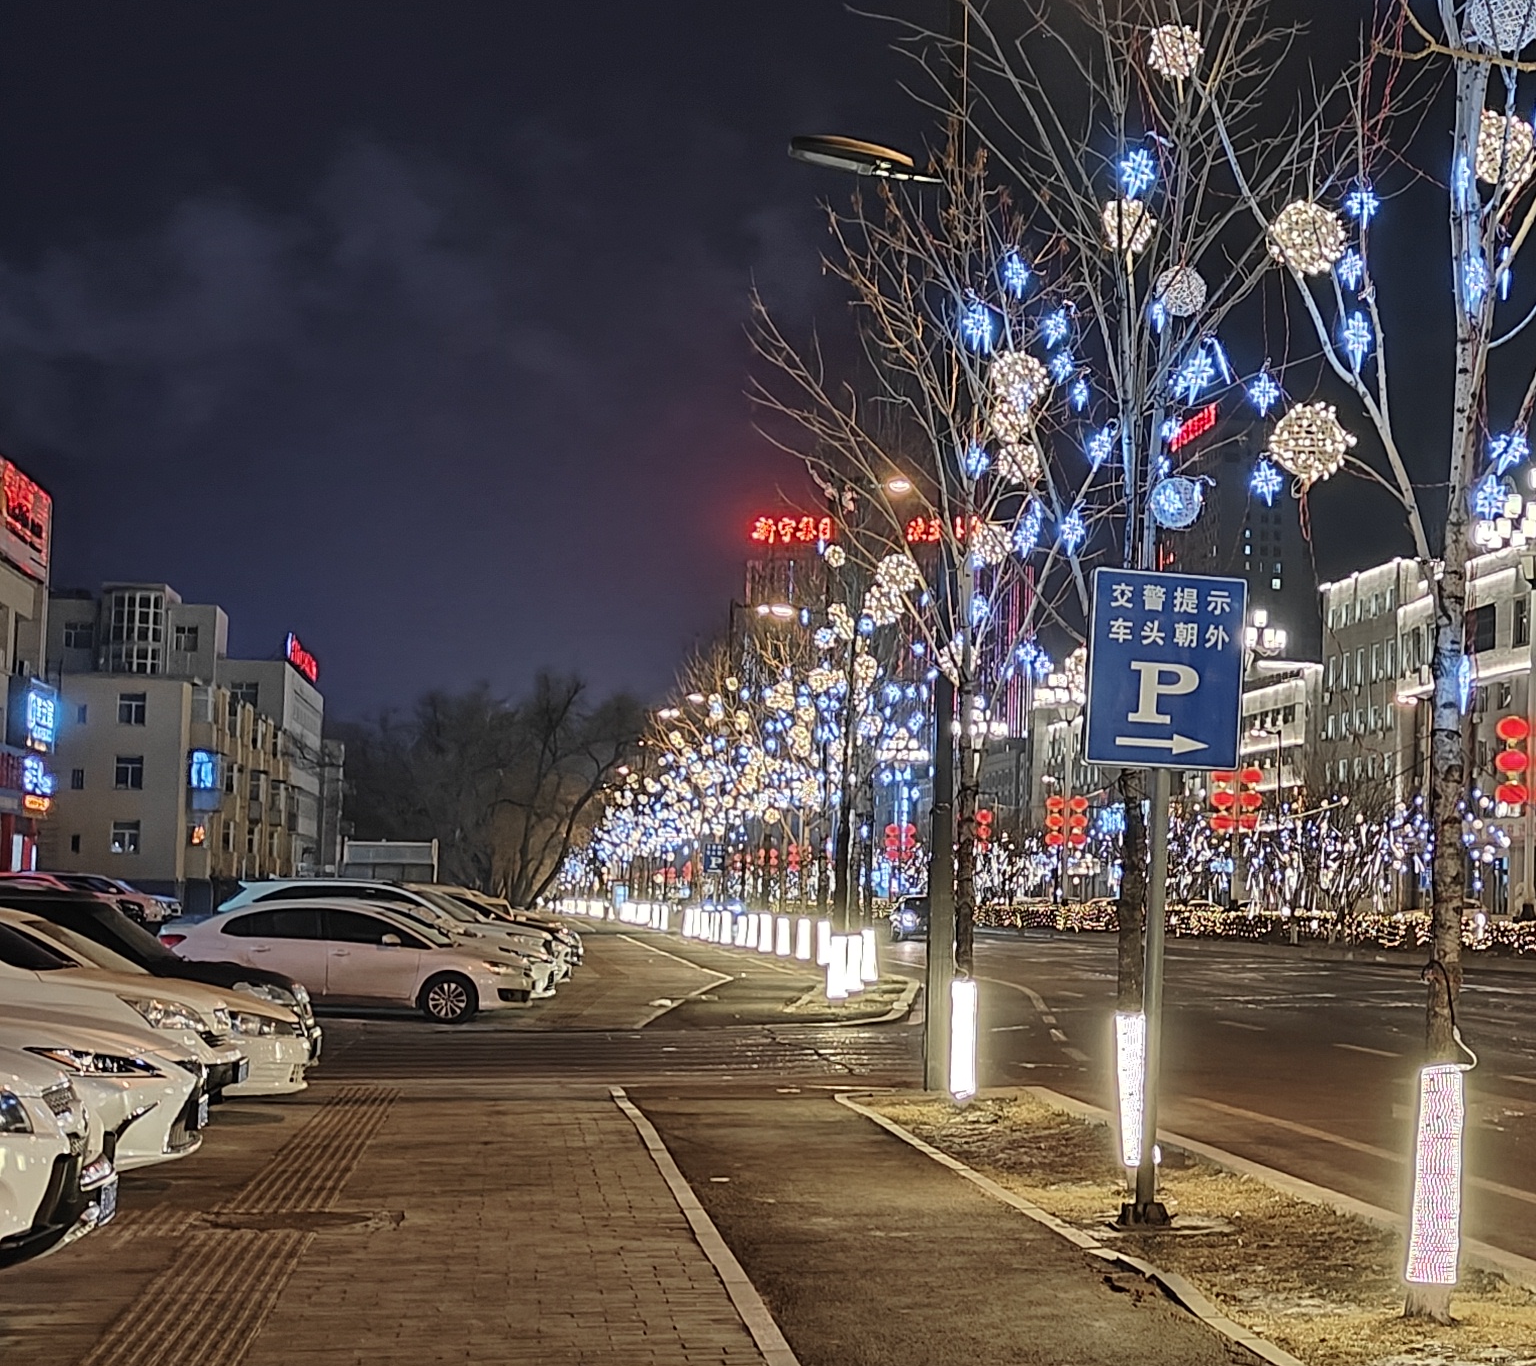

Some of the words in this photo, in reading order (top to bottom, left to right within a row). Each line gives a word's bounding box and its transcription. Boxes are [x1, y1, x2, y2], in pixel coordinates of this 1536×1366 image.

[1110, 582, 1231, 615] 交警提示
[1108, 617, 1230, 651] 车头朝外
[1127, 660, 1200, 725] P
[709, 856, 723, 869] P
